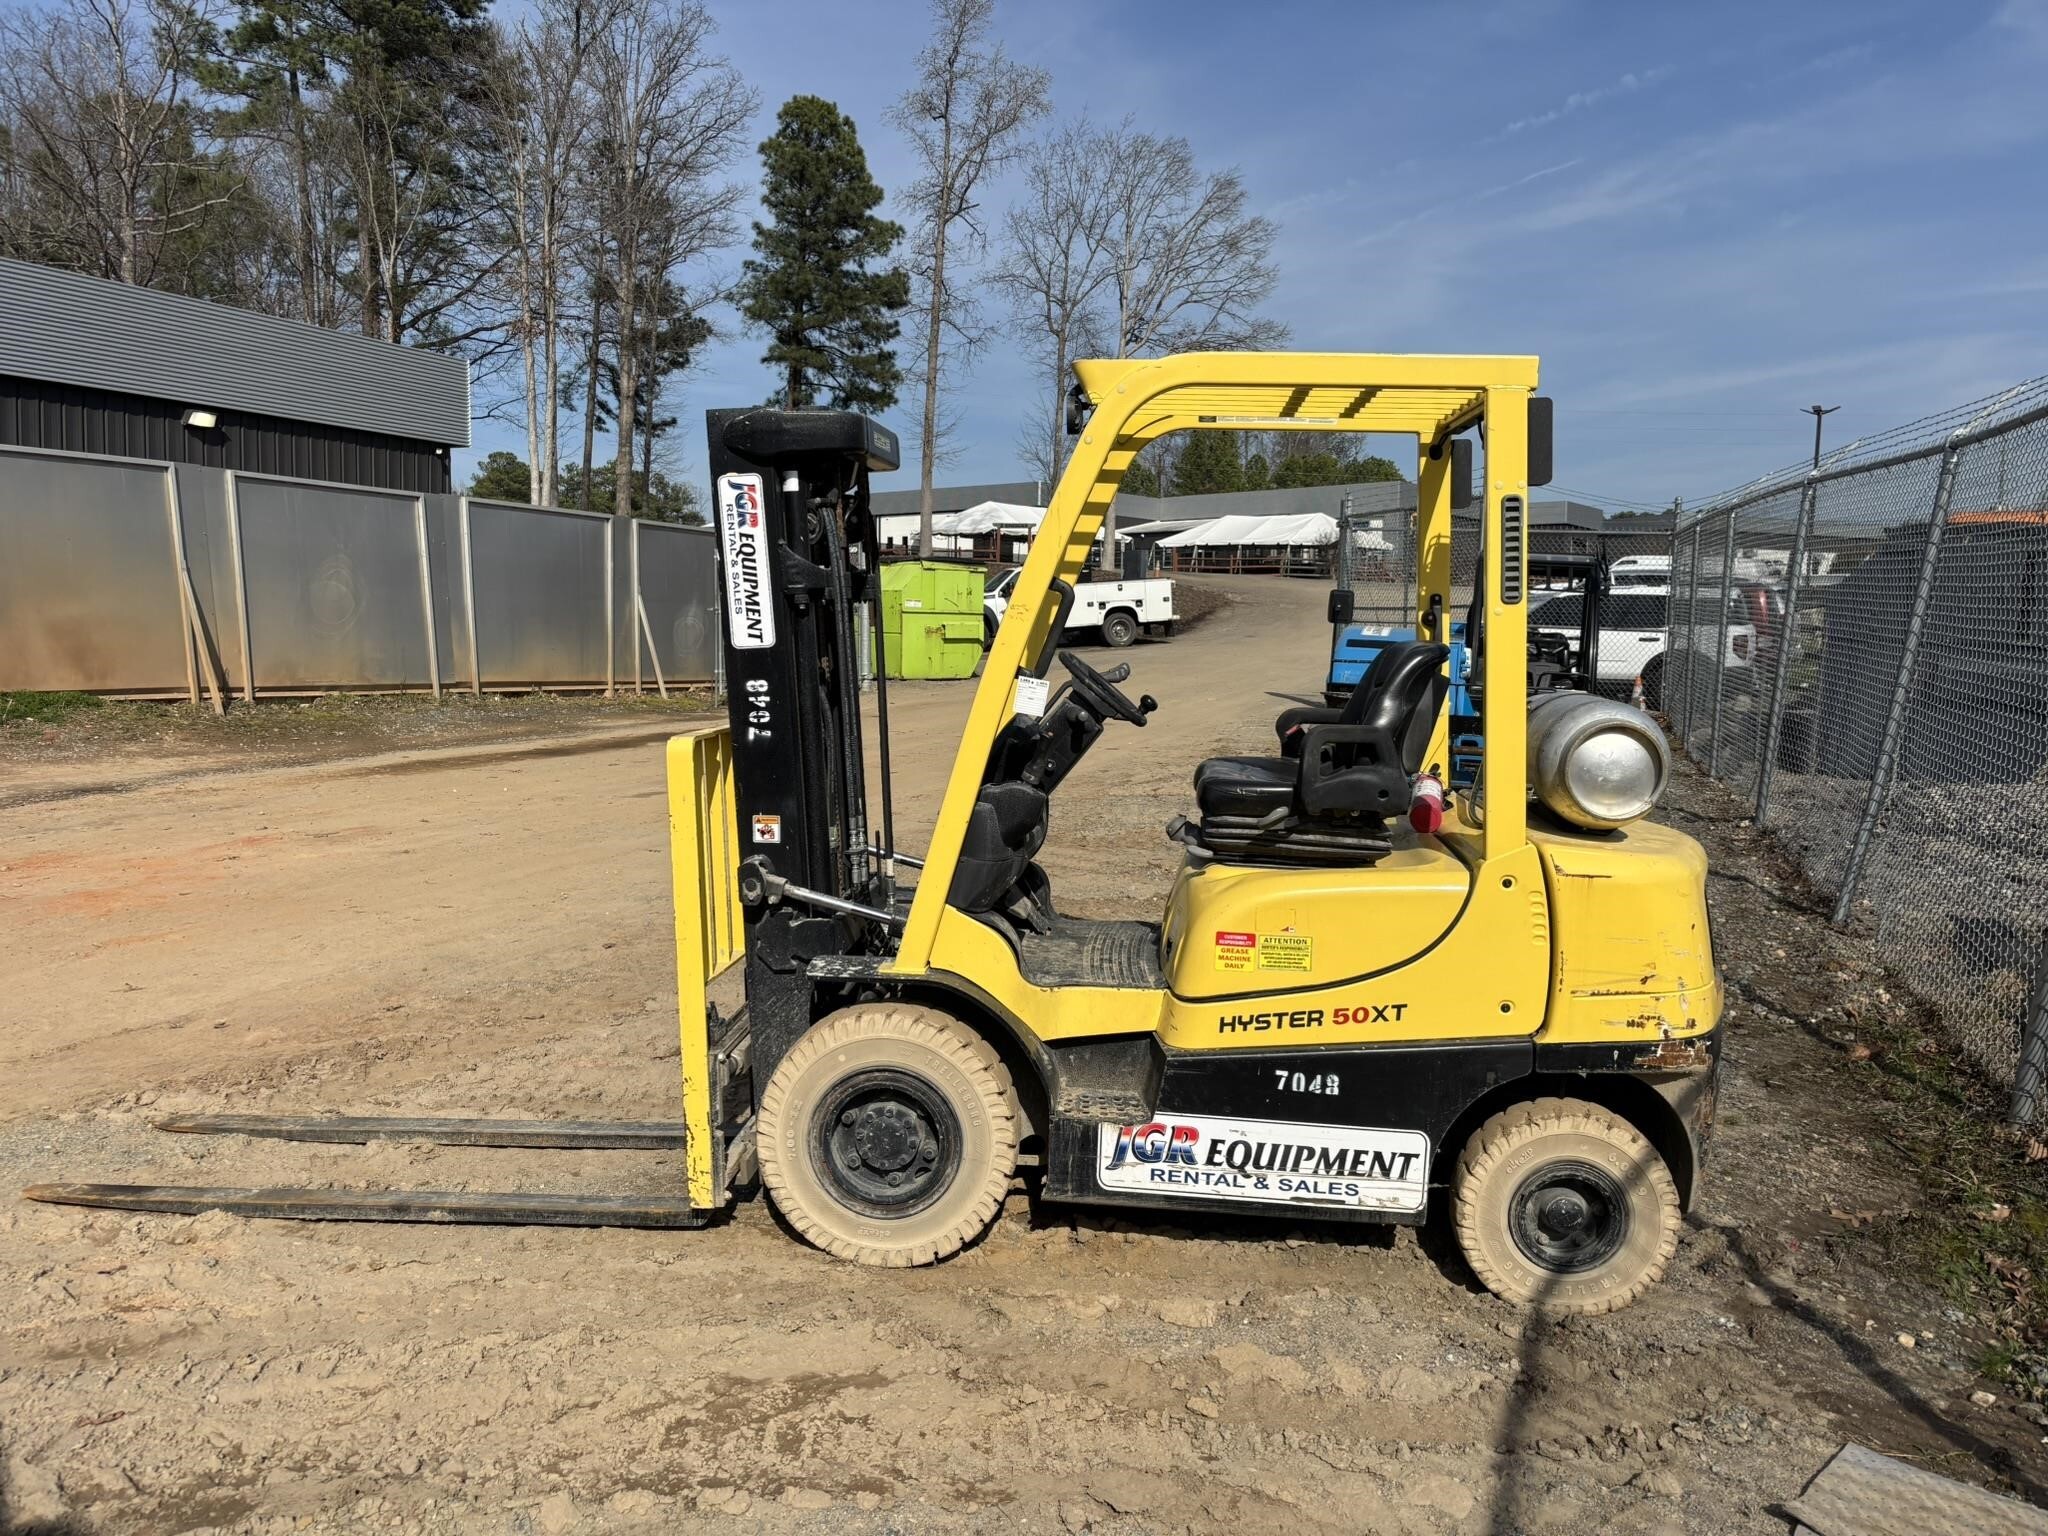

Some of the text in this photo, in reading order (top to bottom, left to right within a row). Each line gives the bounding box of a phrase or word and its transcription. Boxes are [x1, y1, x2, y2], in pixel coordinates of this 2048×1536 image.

[726, 504, 743, 615] RENTAL & SALES
[728, 480, 764, 643] JGR EQUIPMENT
[746, 680, 771, 741] 7048
[1220, 947, 1249, 955] GREASE
[1263, 937, 1308, 945] ATTENTION
[1218, 954, 1252, 962] MACHINE
[1219, 1009, 1324, 1033] HYSTER
[924, 1055, 982, 1128] TRELLEBORG
[1275, 1069, 1340, 1095] 7048
[1105, 1122, 1421, 1180] JGR EQUIPMENT
[1149, 1167, 1360, 1197] RENTAL & SALES
[1503, 1261, 1622, 1296] TRELLEBORG
